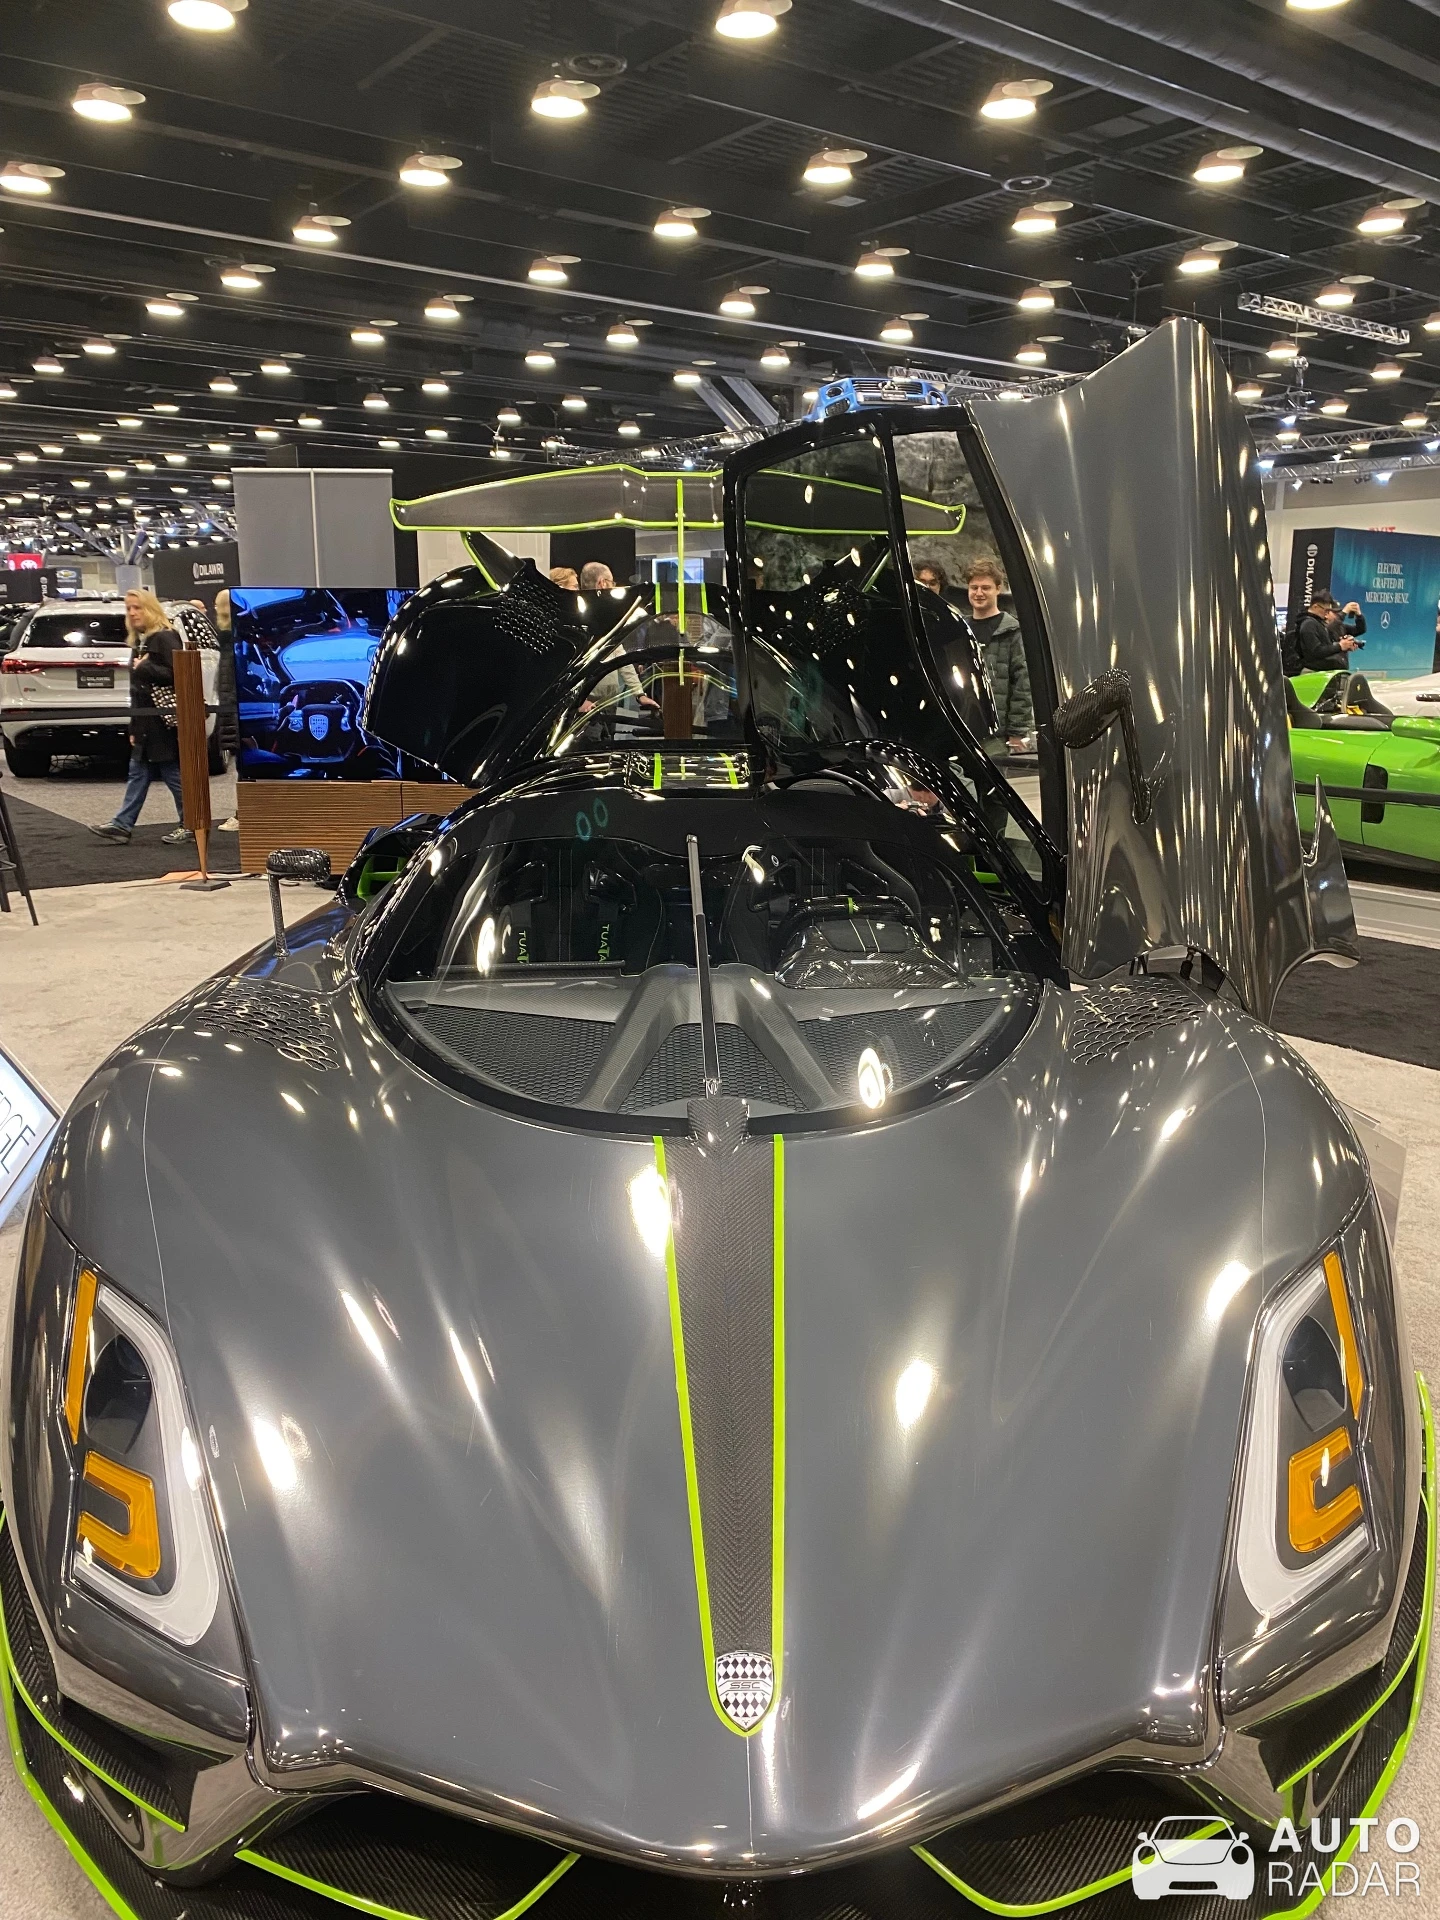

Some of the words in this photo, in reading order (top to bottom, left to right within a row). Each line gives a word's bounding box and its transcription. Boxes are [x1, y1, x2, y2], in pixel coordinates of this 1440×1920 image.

[199, 563, 224, 576] DILAWRI
[1303, 558, 1316, 607] DILAWRI
[1372, 577, 1397, 589] CRAFTED
[1397, 578, 1405, 590] BY
[729, 1681, 761, 1690] SSC
